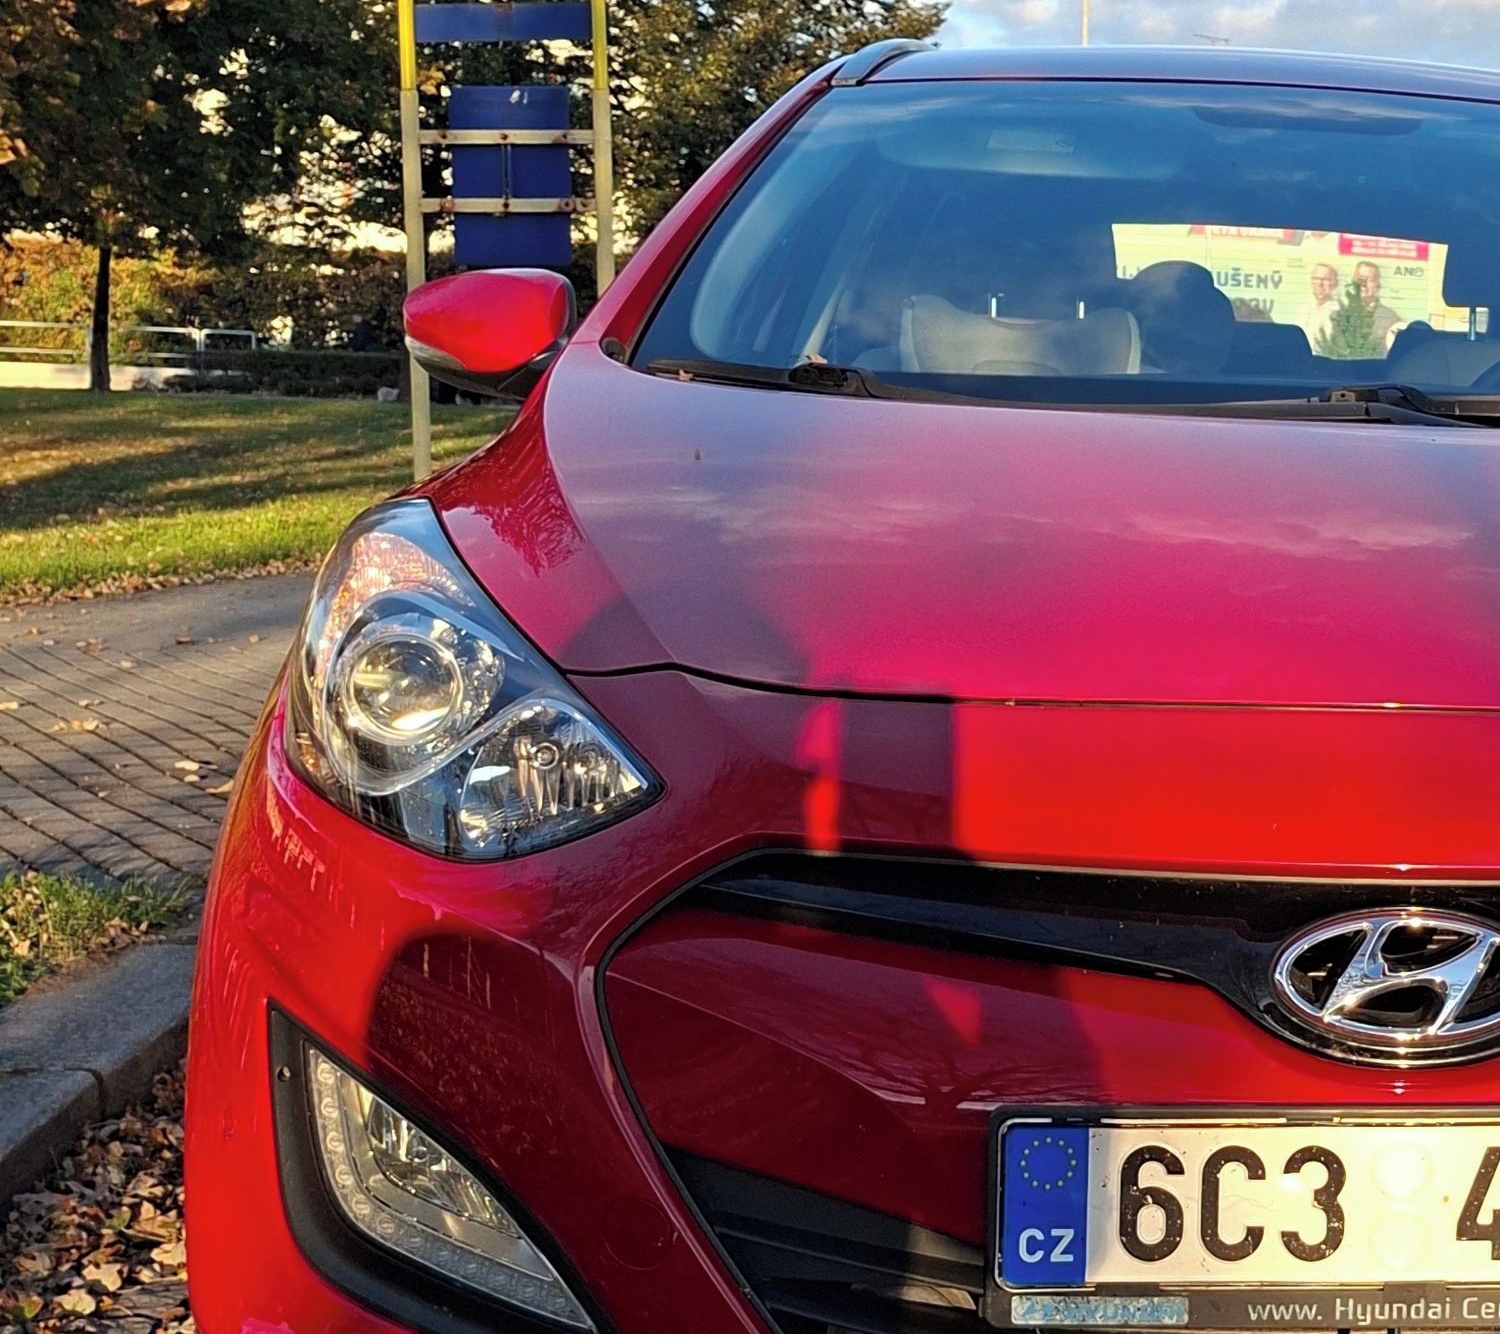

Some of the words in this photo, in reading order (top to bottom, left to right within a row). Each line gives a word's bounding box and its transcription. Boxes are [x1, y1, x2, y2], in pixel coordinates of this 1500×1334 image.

[1216, 267, 1283, 289] UŠENÝ
[1119, 1144, 1347, 1262] 6C3
[1018, 1228, 1075, 1263] CZ
[1334, 1297, 1451, 1326] Hyundai
